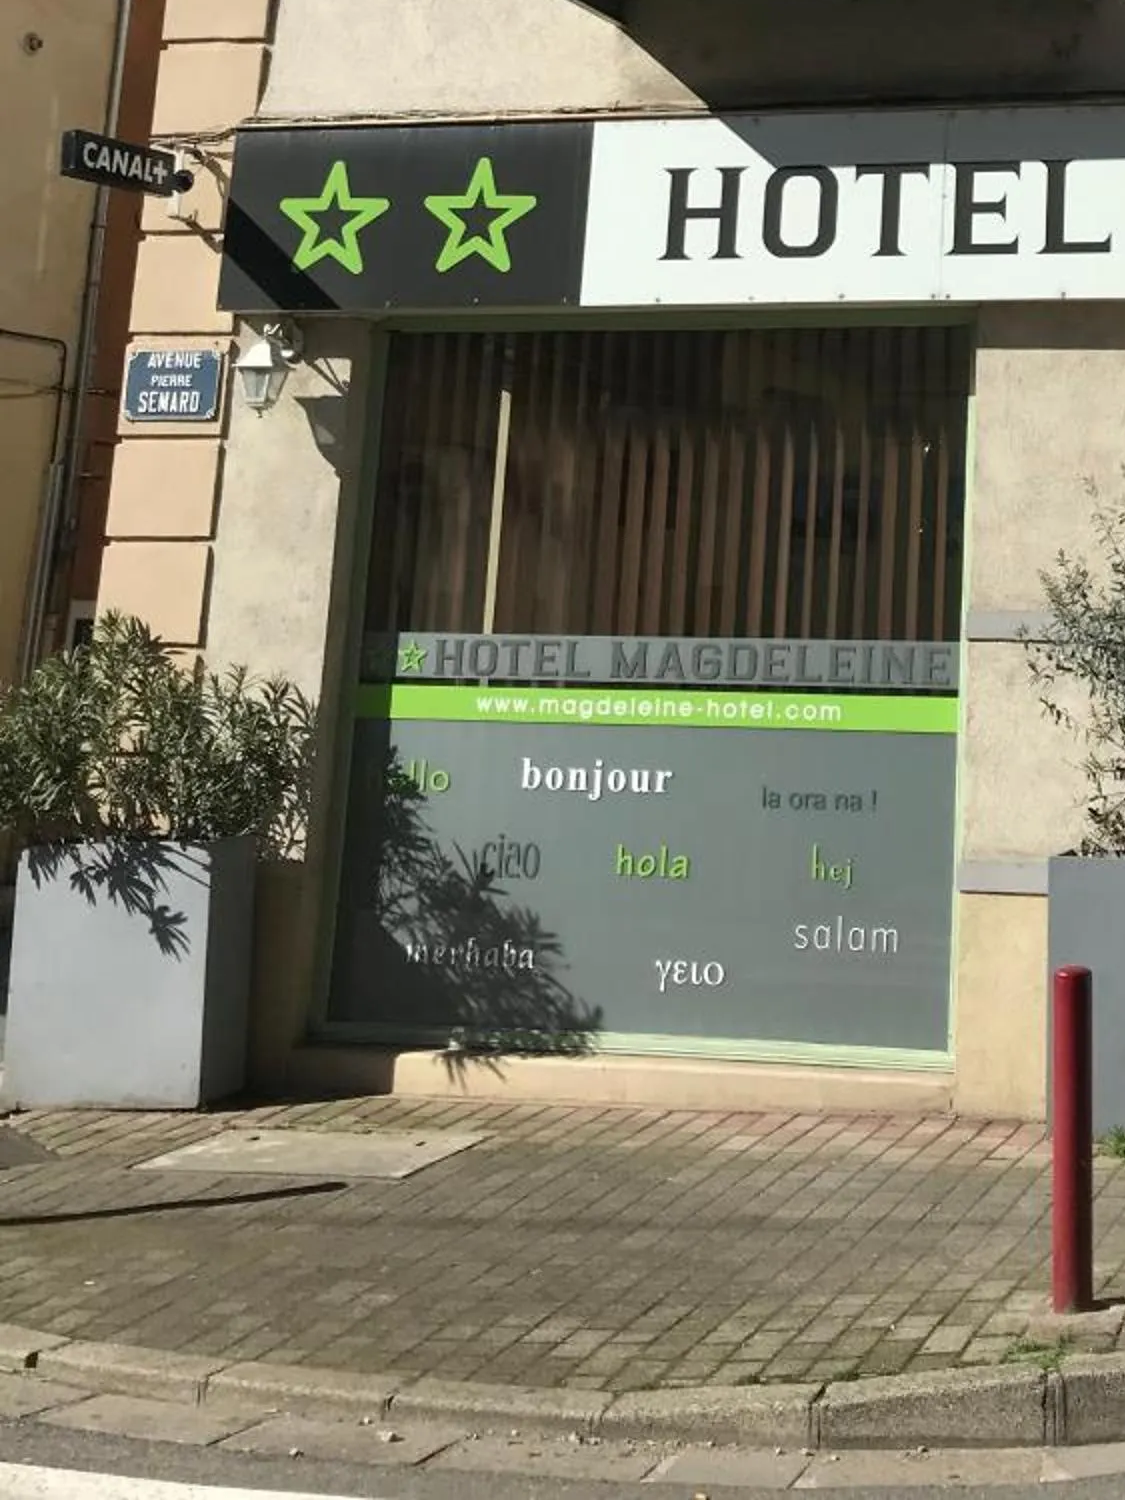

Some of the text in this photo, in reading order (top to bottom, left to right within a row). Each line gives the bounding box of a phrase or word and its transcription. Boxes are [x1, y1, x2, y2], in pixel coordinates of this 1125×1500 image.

[82, 141, 169, 185] CANAL+
[657, 160, 1112, 260] HOTEL
[147, 352, 202, 369] AVENUE
[151, 373, 193, 387] PIERRE
[432, 638, 951, 686] HOTEL MAGDELEINE
[476, 696, 842, 723] www.magdeleine-hotel.com
[521, 757, 674, 801] bonjour
[834, 792, 863, 813] na
[616, 842, 690, 880] hola
[811, 843, 854, 890] hej
[794, 914, 899, 953] salam
[404, 936, 535, 970] merhaba
